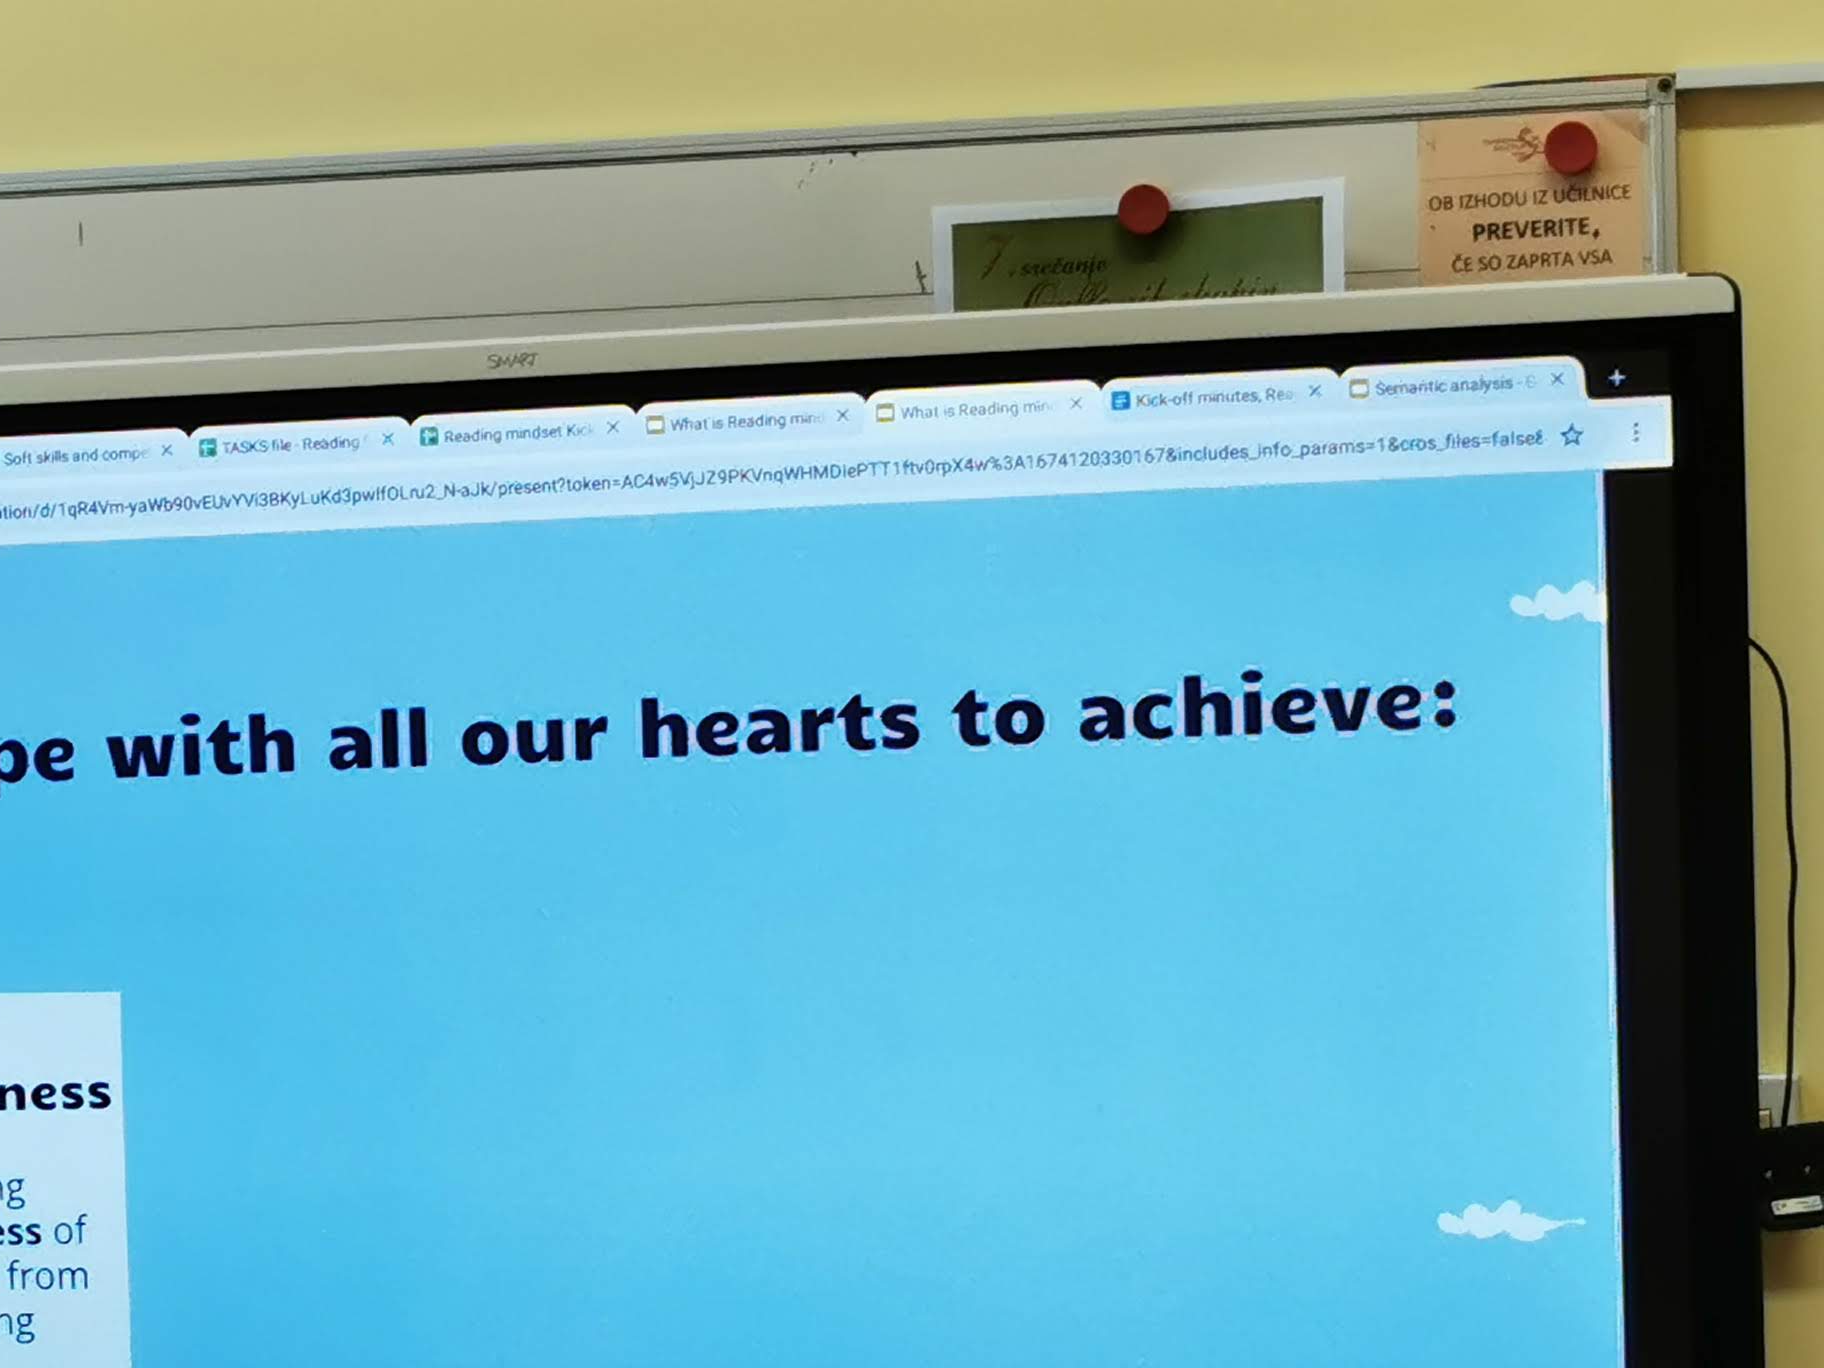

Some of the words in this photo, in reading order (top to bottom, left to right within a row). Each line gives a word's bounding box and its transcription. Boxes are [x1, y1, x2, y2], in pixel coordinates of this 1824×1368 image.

[1428, 195, 1454, 212] OB
[1459, 191, 1527, 210] IZHODU
[1532, 189, 1549, 205] IZ
[1552, 183, 1632, 204] UČILNICE
[1472, 216, 1601, 243] PREVERITE,
[1451, 253, 1473, 274] ČE
[1477, 254, 1502, 272] SO
[1506, 251, 1577, 270] ZAPRTA
[1579, 248, 1614, 266] VSA
[487, 351, 539, 370] SMART
[1375, 377, 1448, 396] Semantic
[1449, 373, 1514, 395] analysis
[1135, 390, 1194, 408] Kick-off
[1197, 388, 1263, 405] minutes,
[901, 405, 939, 420] What
[944, 405, 955, 418] is
[958, 400, 1020, 418] Reading
[670, 417, 709, 432] What
[712, 417, 724, 429] is
[727, 413, 787, 430] Reading
[444, 427, 503, 444] Reading
[505, 424, 563, 440] mindset
[222, 439, 268, 454] TASKS
[271, 438, 292, 452] file
[302, 436, 360, 451] Reading
[3, 450, 33, 467] Soft
[36, 448, 70, 464] skills
[73, 447, 99, 463] and
[105, 712, 295, 779] with
[329, 706, 428, 771] all
[461, 715, 609, 766] our
[641, 693, 920, 759] hearts
[951, 689, 1045, 747] to
[1079, 669, 1456, 742] achieve:
[53, 1213, 88, 1245] of
[6, 1259, 89, 1290] from
